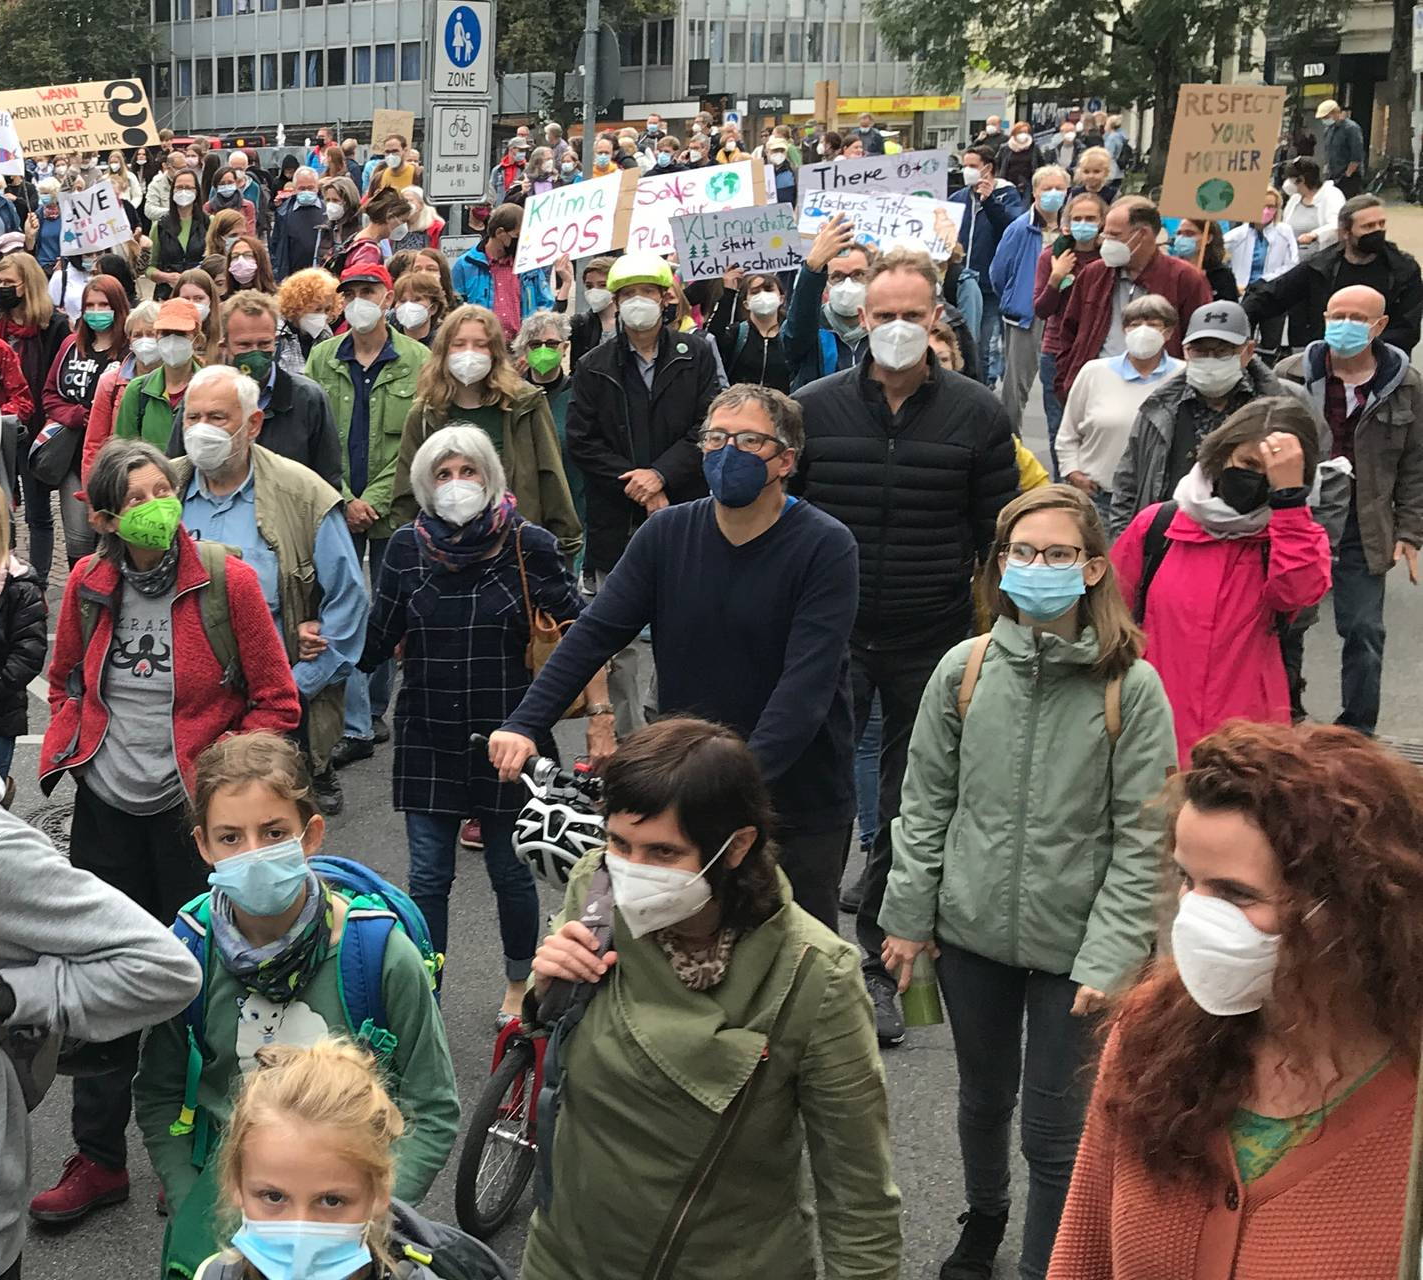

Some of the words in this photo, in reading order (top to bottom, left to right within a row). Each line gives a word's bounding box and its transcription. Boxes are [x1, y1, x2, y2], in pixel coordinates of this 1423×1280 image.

[447, 72, 476, 87] ZONE
[36, 86, 79, 101] WANN
[7, 104, 41, 121] WENN
[43, 101, 77, 117] NICHT
[1184, 92, 1280, 117] RESPECT
[50, 118, 87, 133] WER
[1210, 122, 1256, 144] YOUR
[19, 137, 55, 154] WENN
[57, 134, 90, 152] NICHT
[94, 131, 122, 147] WIR
[453, 140, 467, 151] frei
[1183, 149, 1262, 175] MOTHER
[527, 187, 606, 229] Klima
[536, 214, 604, 263] SOS
[721, 236, 756, 253] statt
